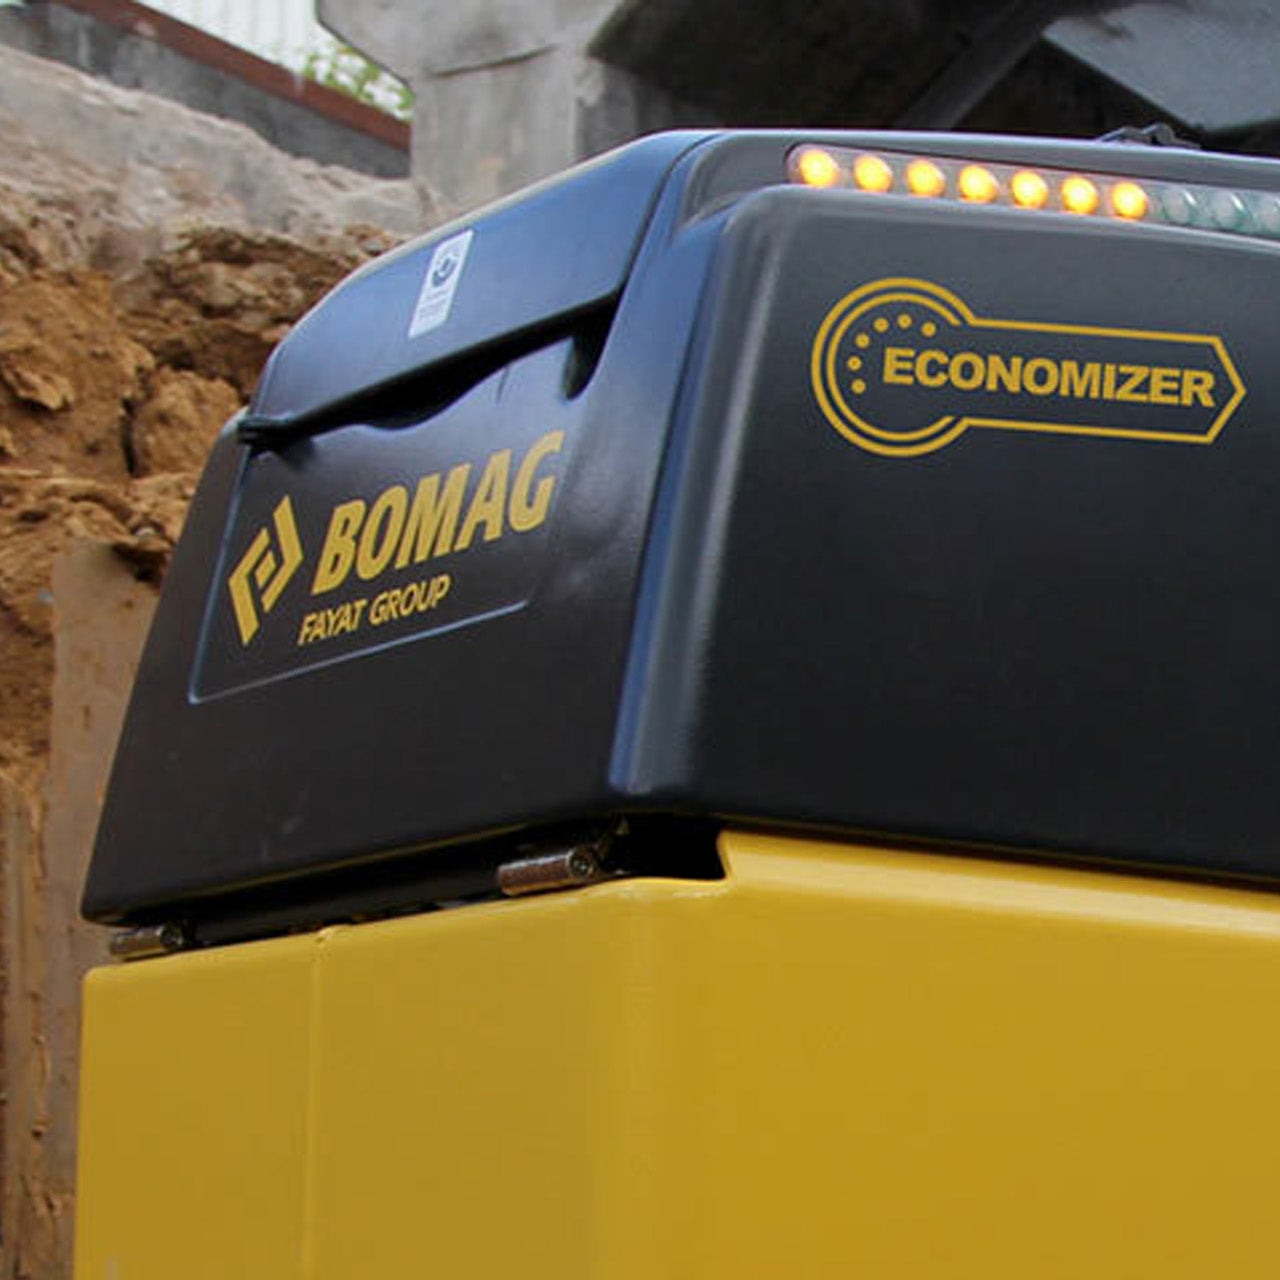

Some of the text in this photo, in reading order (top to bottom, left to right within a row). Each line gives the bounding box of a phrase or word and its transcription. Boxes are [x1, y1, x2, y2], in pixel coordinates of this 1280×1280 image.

[883, 347, 1215, 407] ECONOMIZER
[313, 430, 565, 595] BOMAG
[298, 575, 452, 646] FAYAT GROUP
